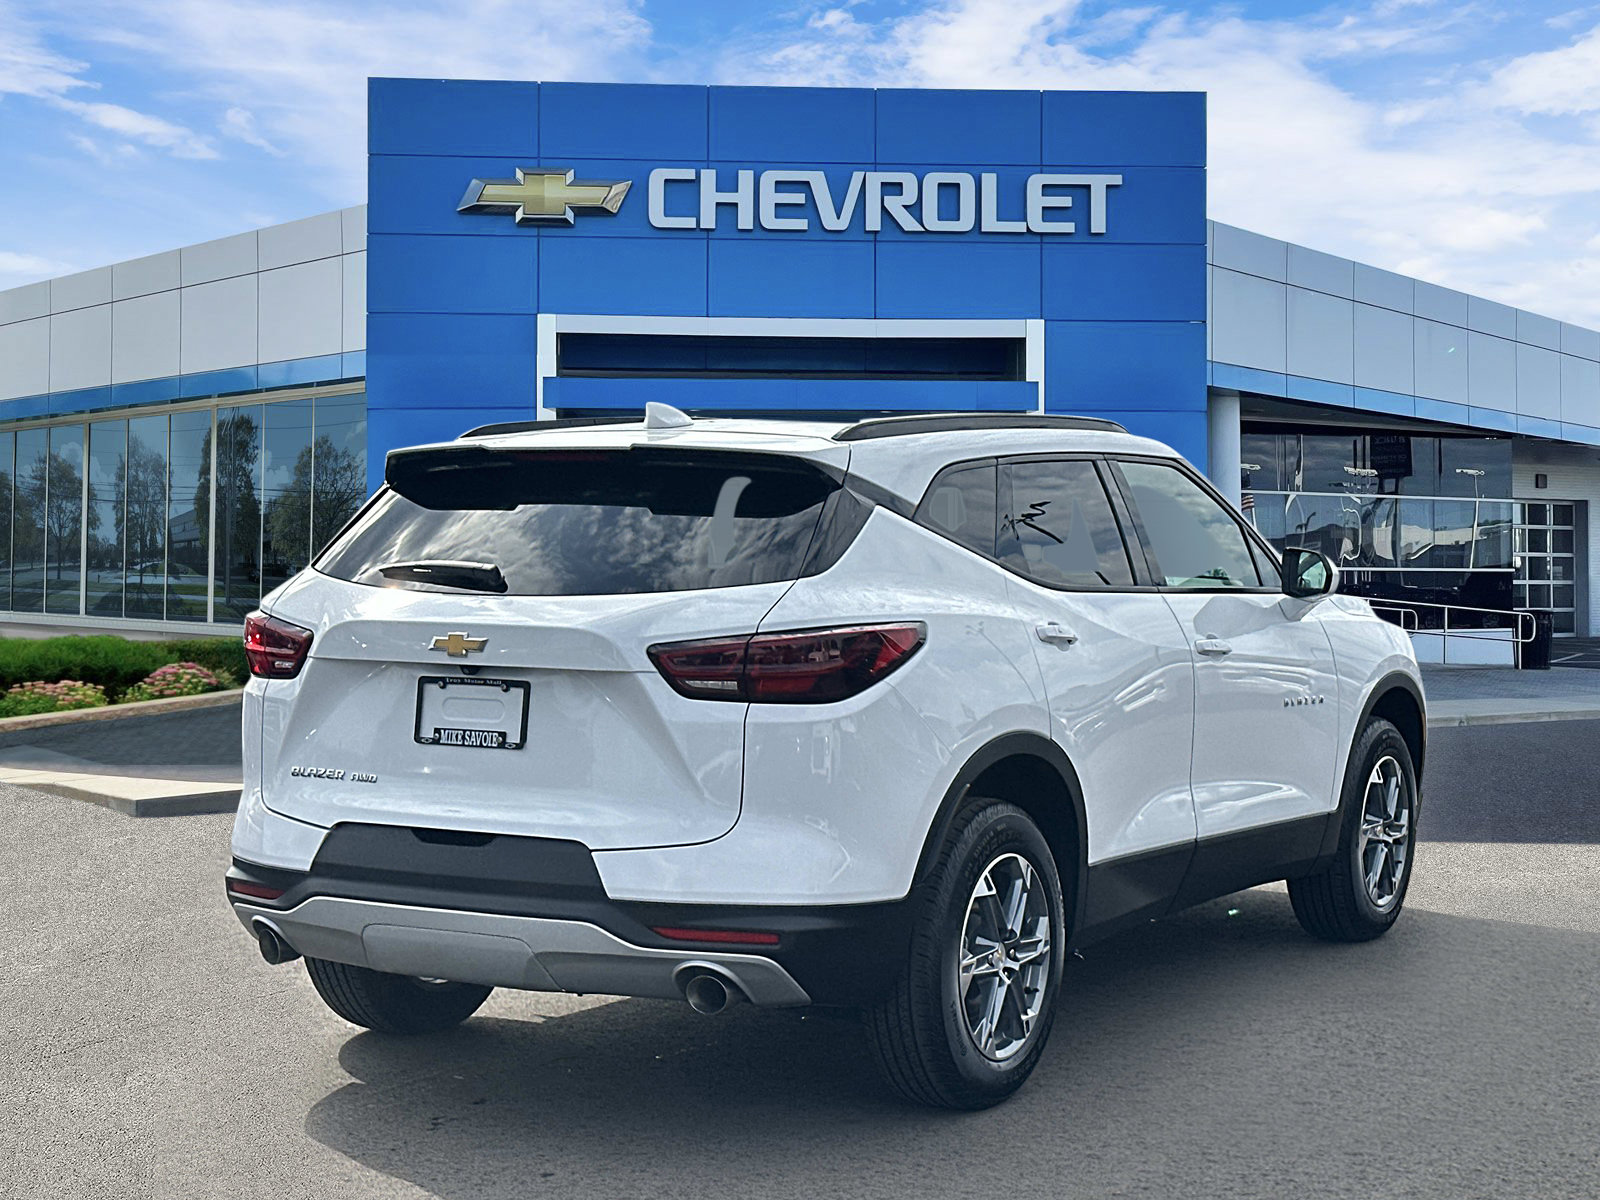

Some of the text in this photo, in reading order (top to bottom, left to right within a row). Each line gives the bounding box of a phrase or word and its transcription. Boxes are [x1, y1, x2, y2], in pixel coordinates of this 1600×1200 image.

[648, 167, 1123, 235] CHEVROLET
[440, 730, 498, 747] MIKE SAVOIE
[291, 766, 378, 783] BLAZER AWD
